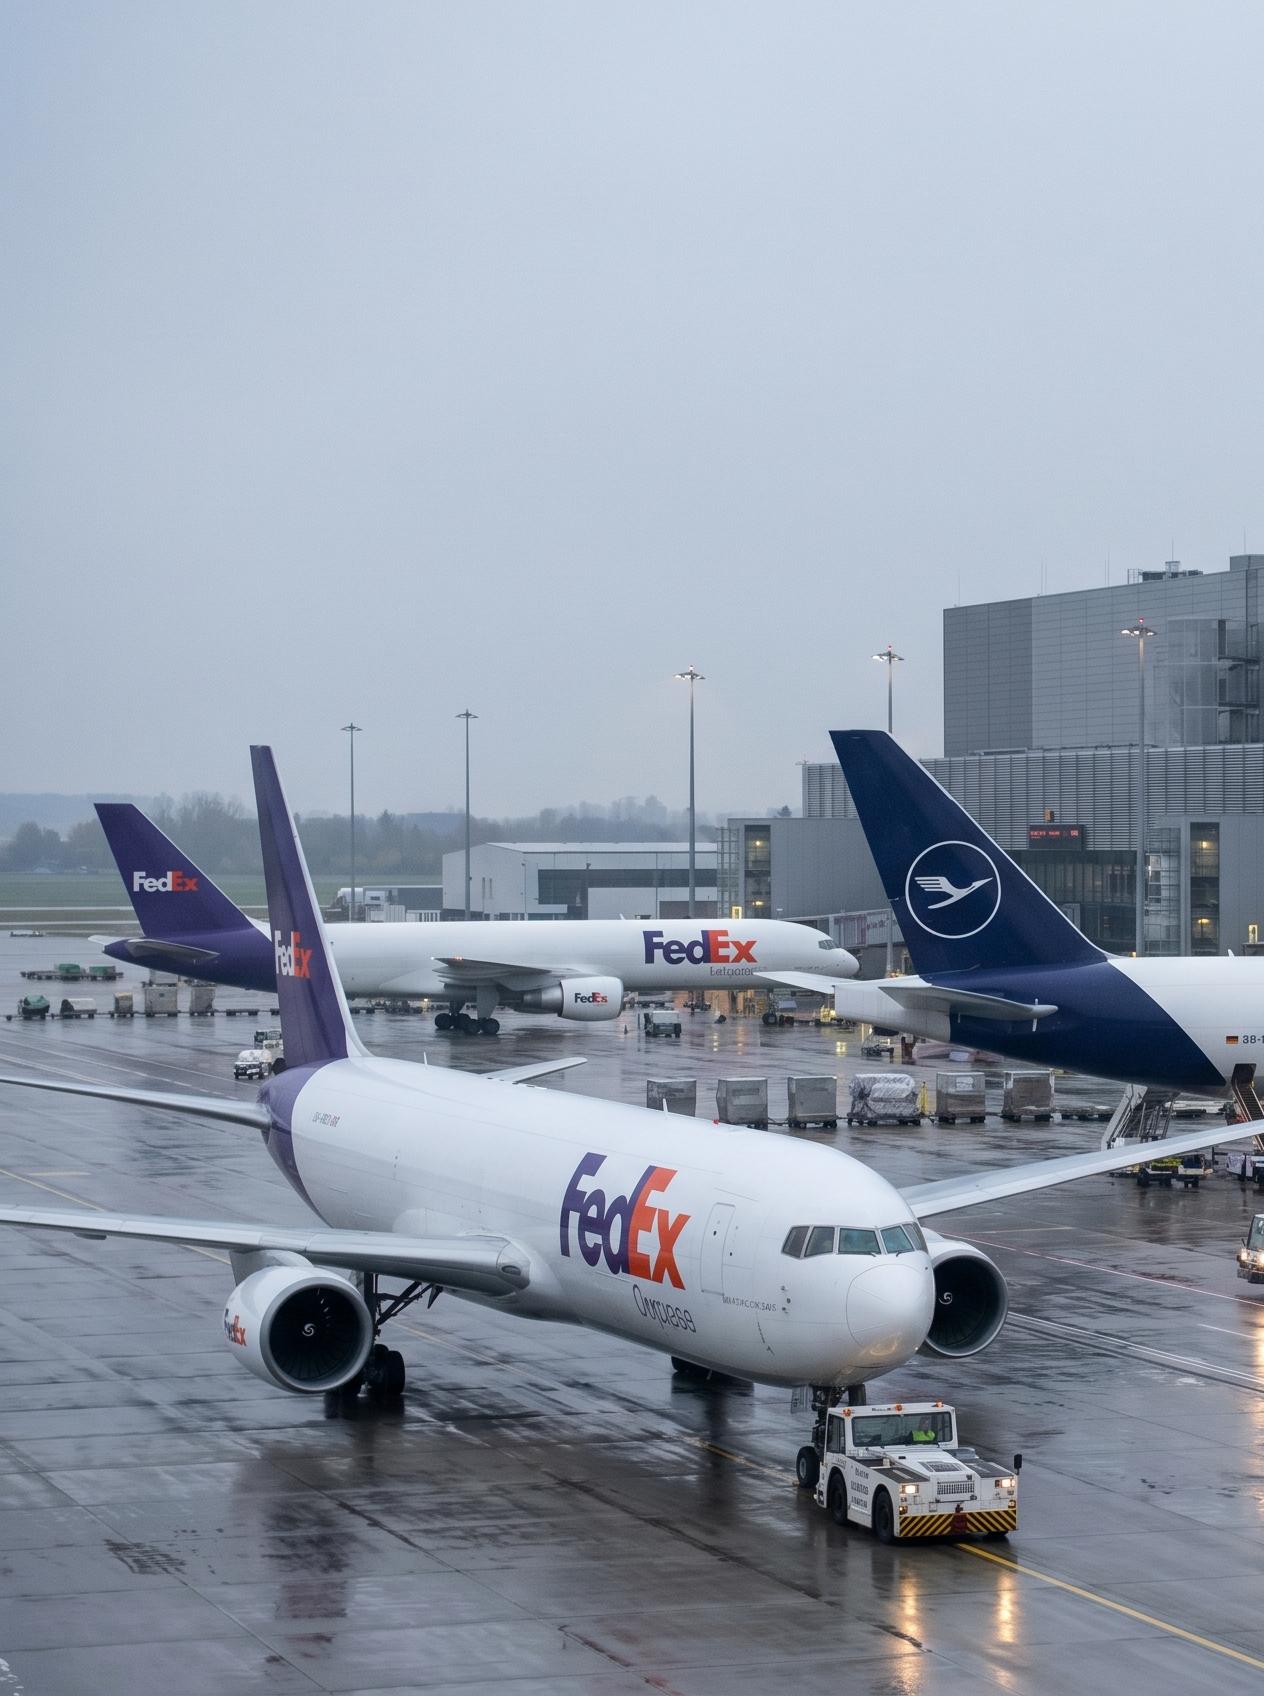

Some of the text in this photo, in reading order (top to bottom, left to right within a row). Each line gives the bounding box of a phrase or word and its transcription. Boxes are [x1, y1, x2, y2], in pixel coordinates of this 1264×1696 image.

[133, 871, 199, 892] FedEx
[274, 929, 313, 978] FedEx
[642, 929, 758, 965] FedEx
[559, 1151, 692, 1291] FedEx
